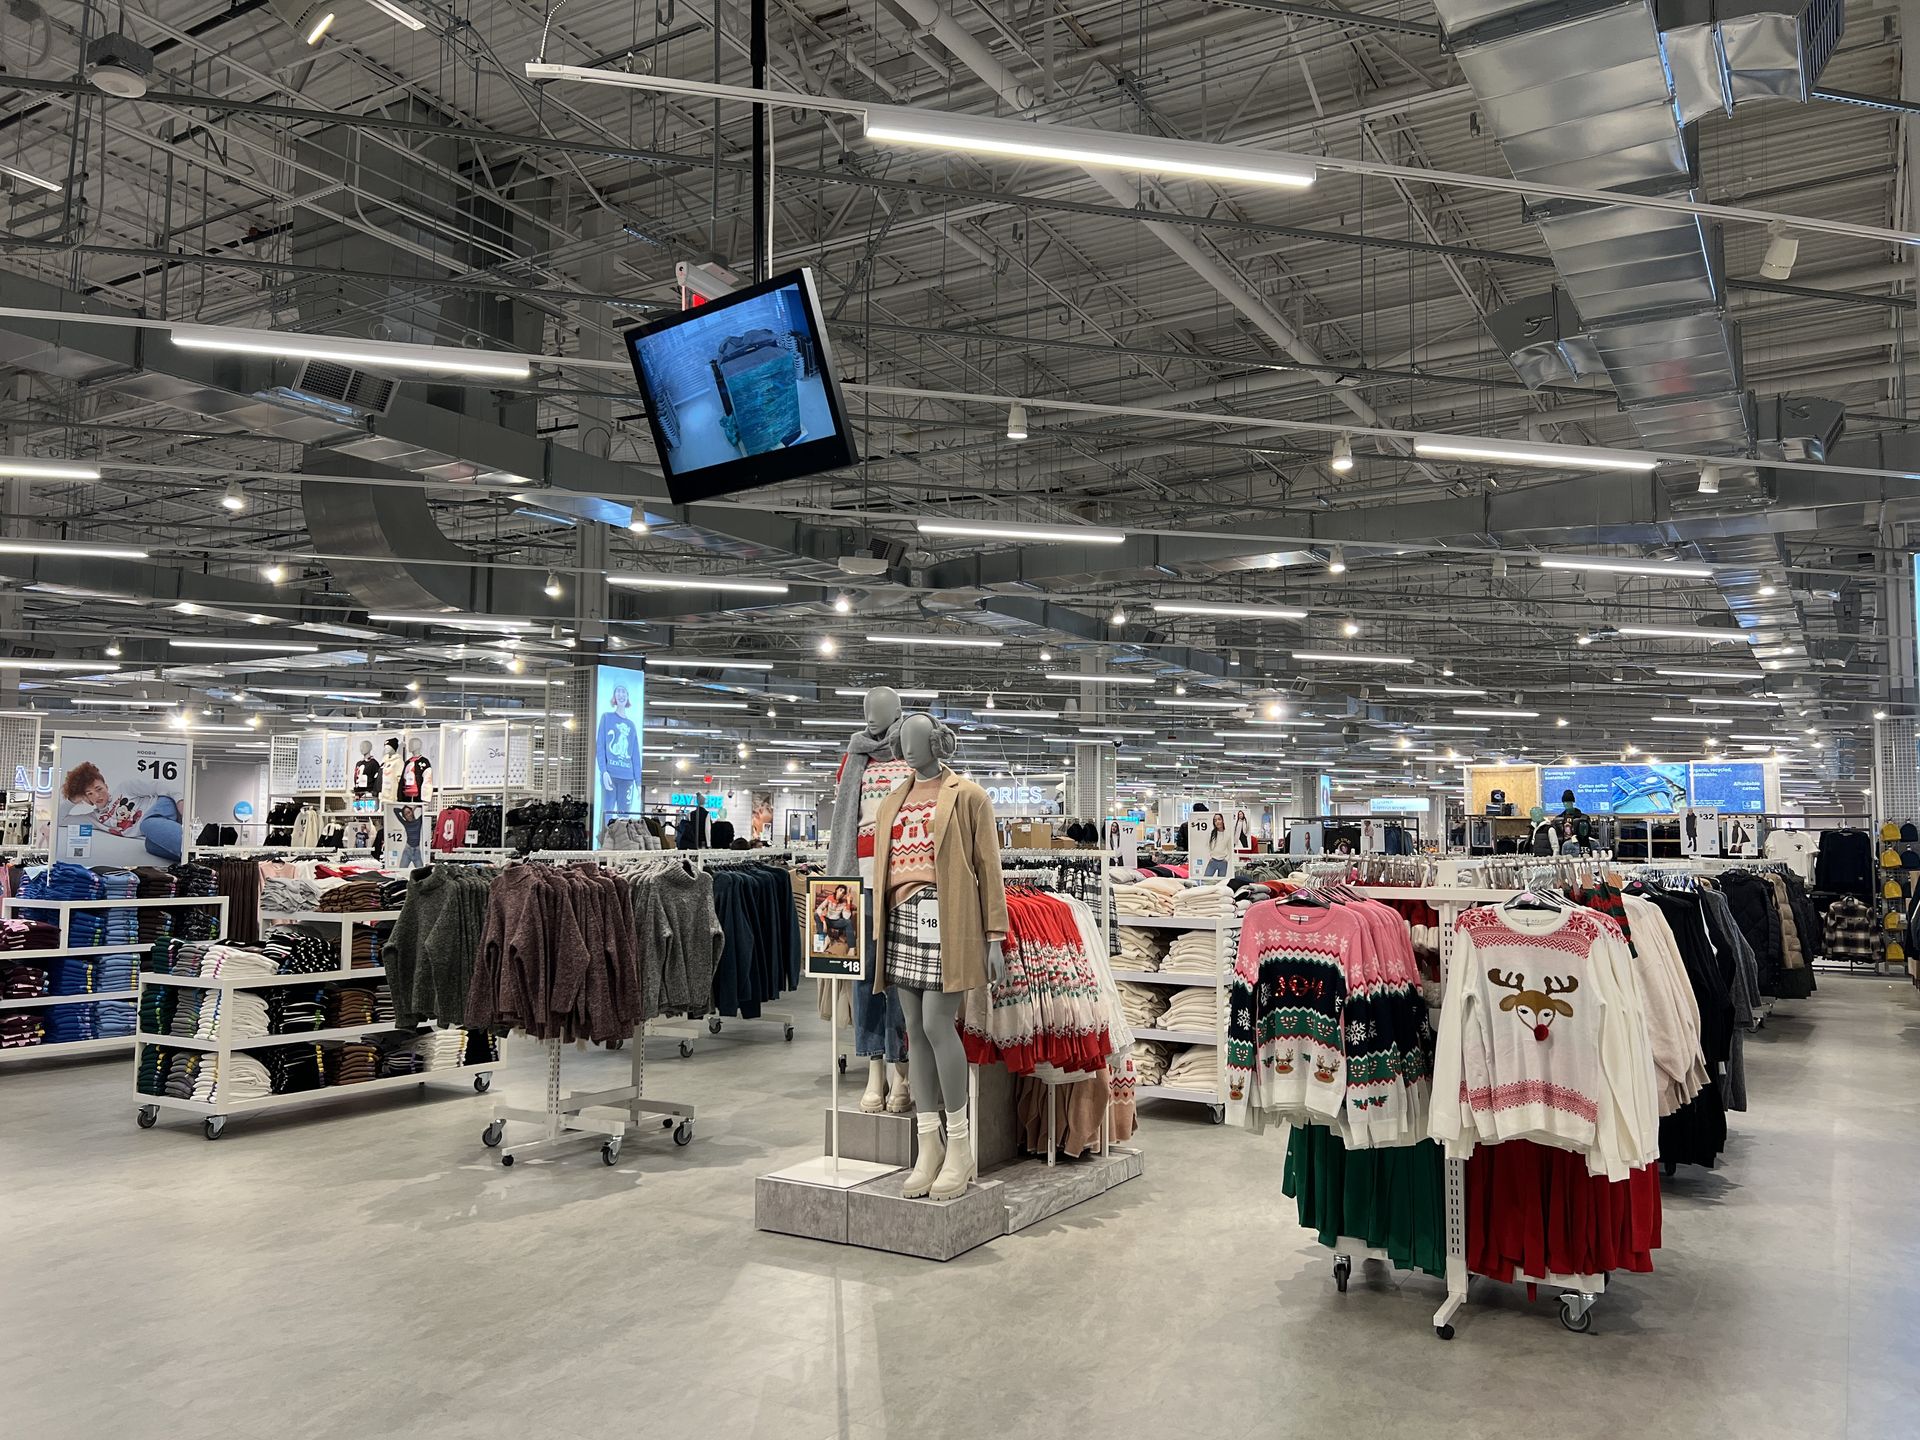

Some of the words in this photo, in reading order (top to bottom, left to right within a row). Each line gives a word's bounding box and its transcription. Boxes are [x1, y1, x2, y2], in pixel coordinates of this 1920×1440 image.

[137, 759, 178, 780] $16
[671, 793, 693, 806] PAY
[1122, 827, 1134, 835] $17
[1191, 822, 1208, 831] $19
[387, 833, 403, 842] $12
[921, 918, 938, 928] $18
[842, 961, 860, 973] $18
